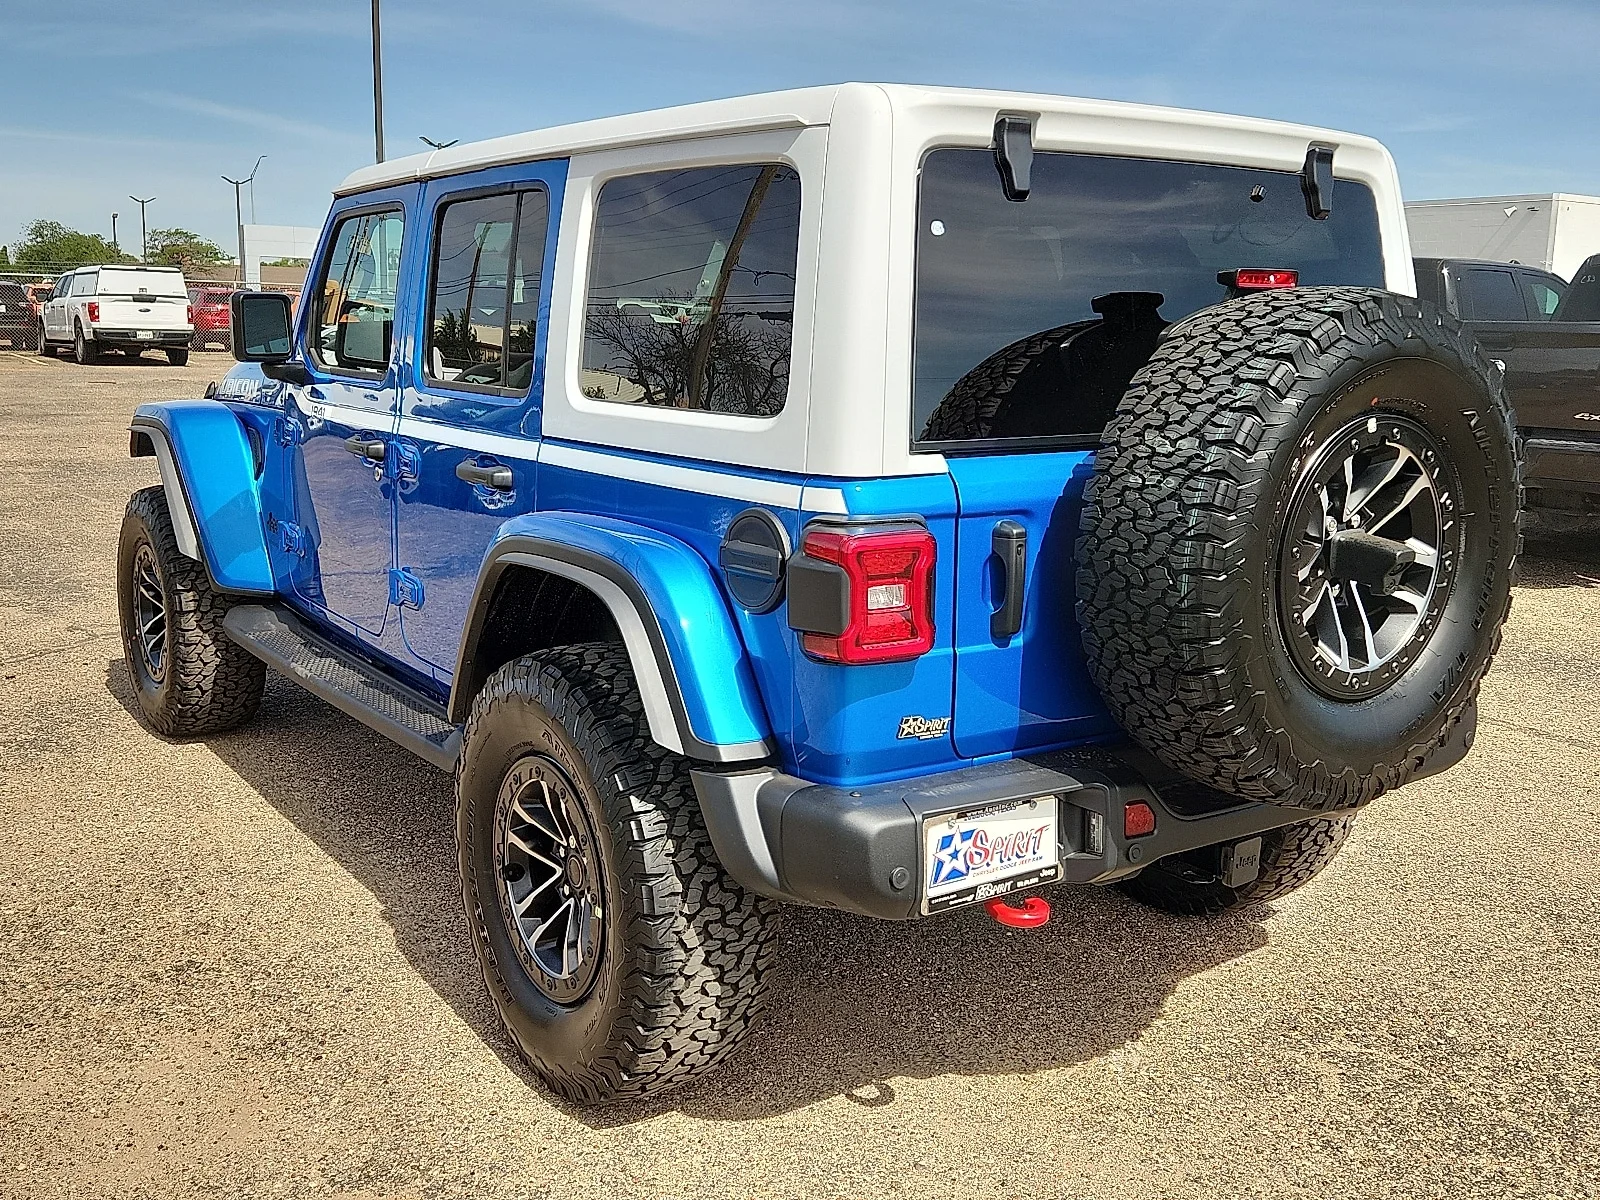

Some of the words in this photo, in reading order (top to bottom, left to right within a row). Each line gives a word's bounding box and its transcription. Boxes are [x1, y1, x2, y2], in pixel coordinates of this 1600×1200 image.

[967, 824, 1051, 867] SPIRIT
[972, 866, 999, 878] CHRYSLER
[999, 861, 1017, 871] DODGE
[1018, 858, 1031, 867] JEEP
